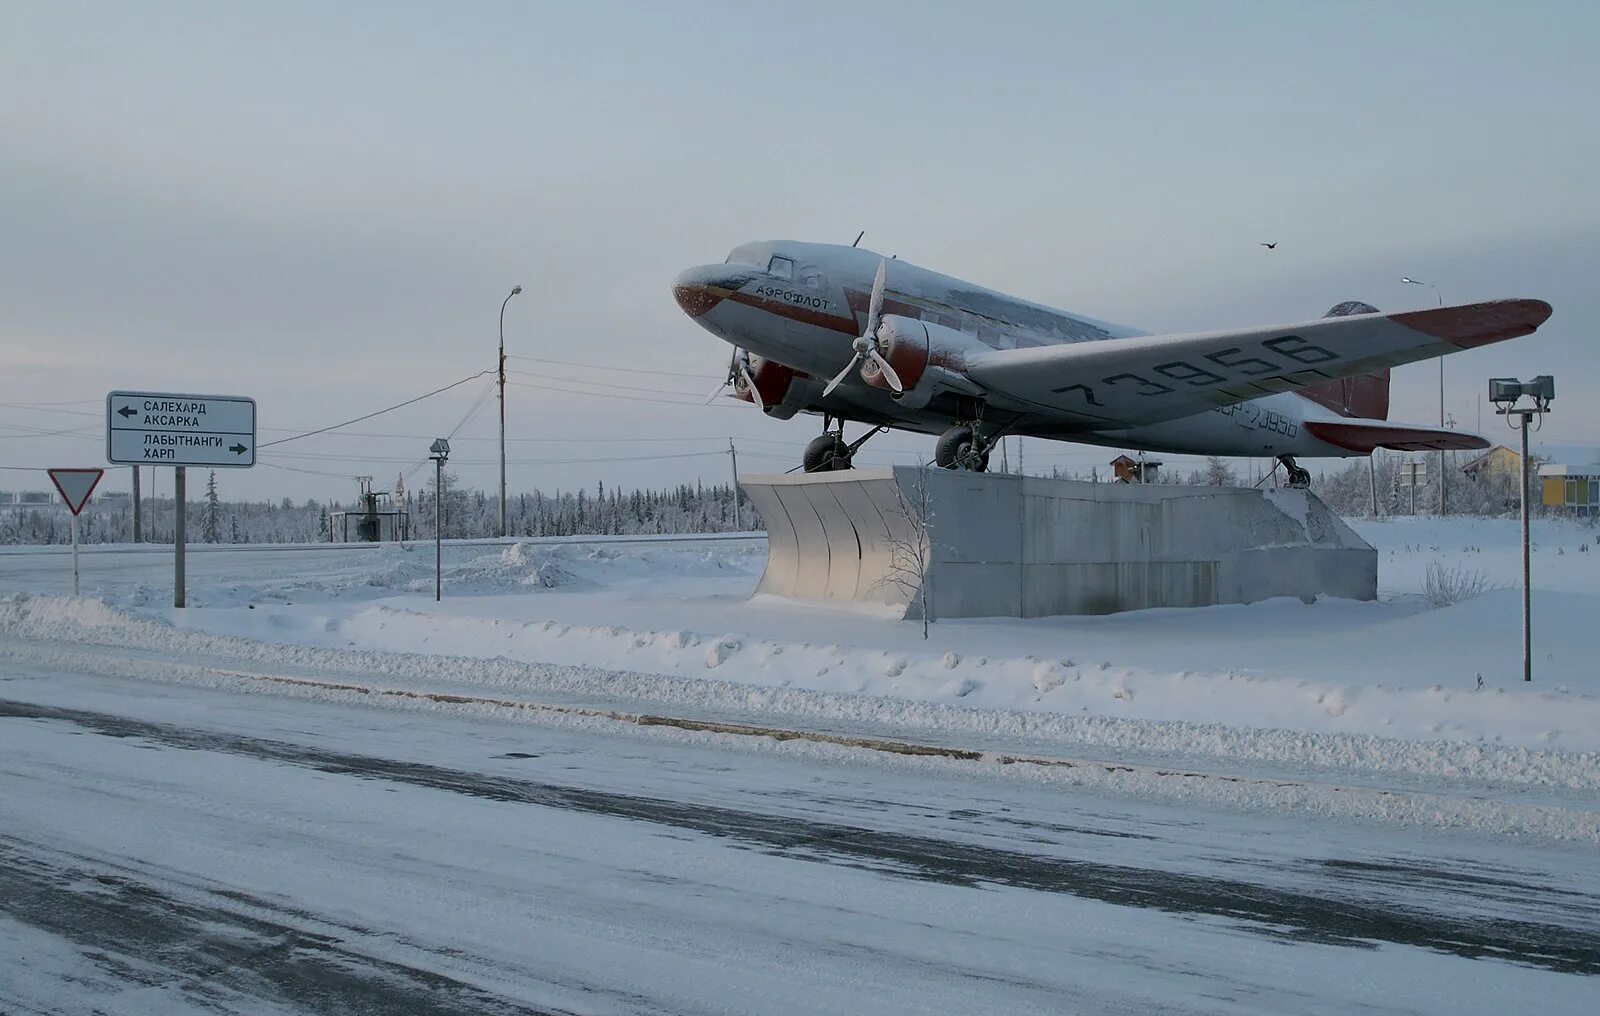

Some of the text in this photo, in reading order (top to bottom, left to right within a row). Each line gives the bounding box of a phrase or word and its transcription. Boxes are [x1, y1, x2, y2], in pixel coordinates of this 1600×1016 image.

[756, 286, 830, 309] АЭРОФЛОТ
[1051, 335, 1341, 407] 73956
[143, 400, 206, 415] САЛЕХАРД
[143, 415, 200, 427] АКСАРКА
[143, 434, 223, 447] ЛАБЫТНАНГИ
[143, 448, 175, 459] ХАРП
